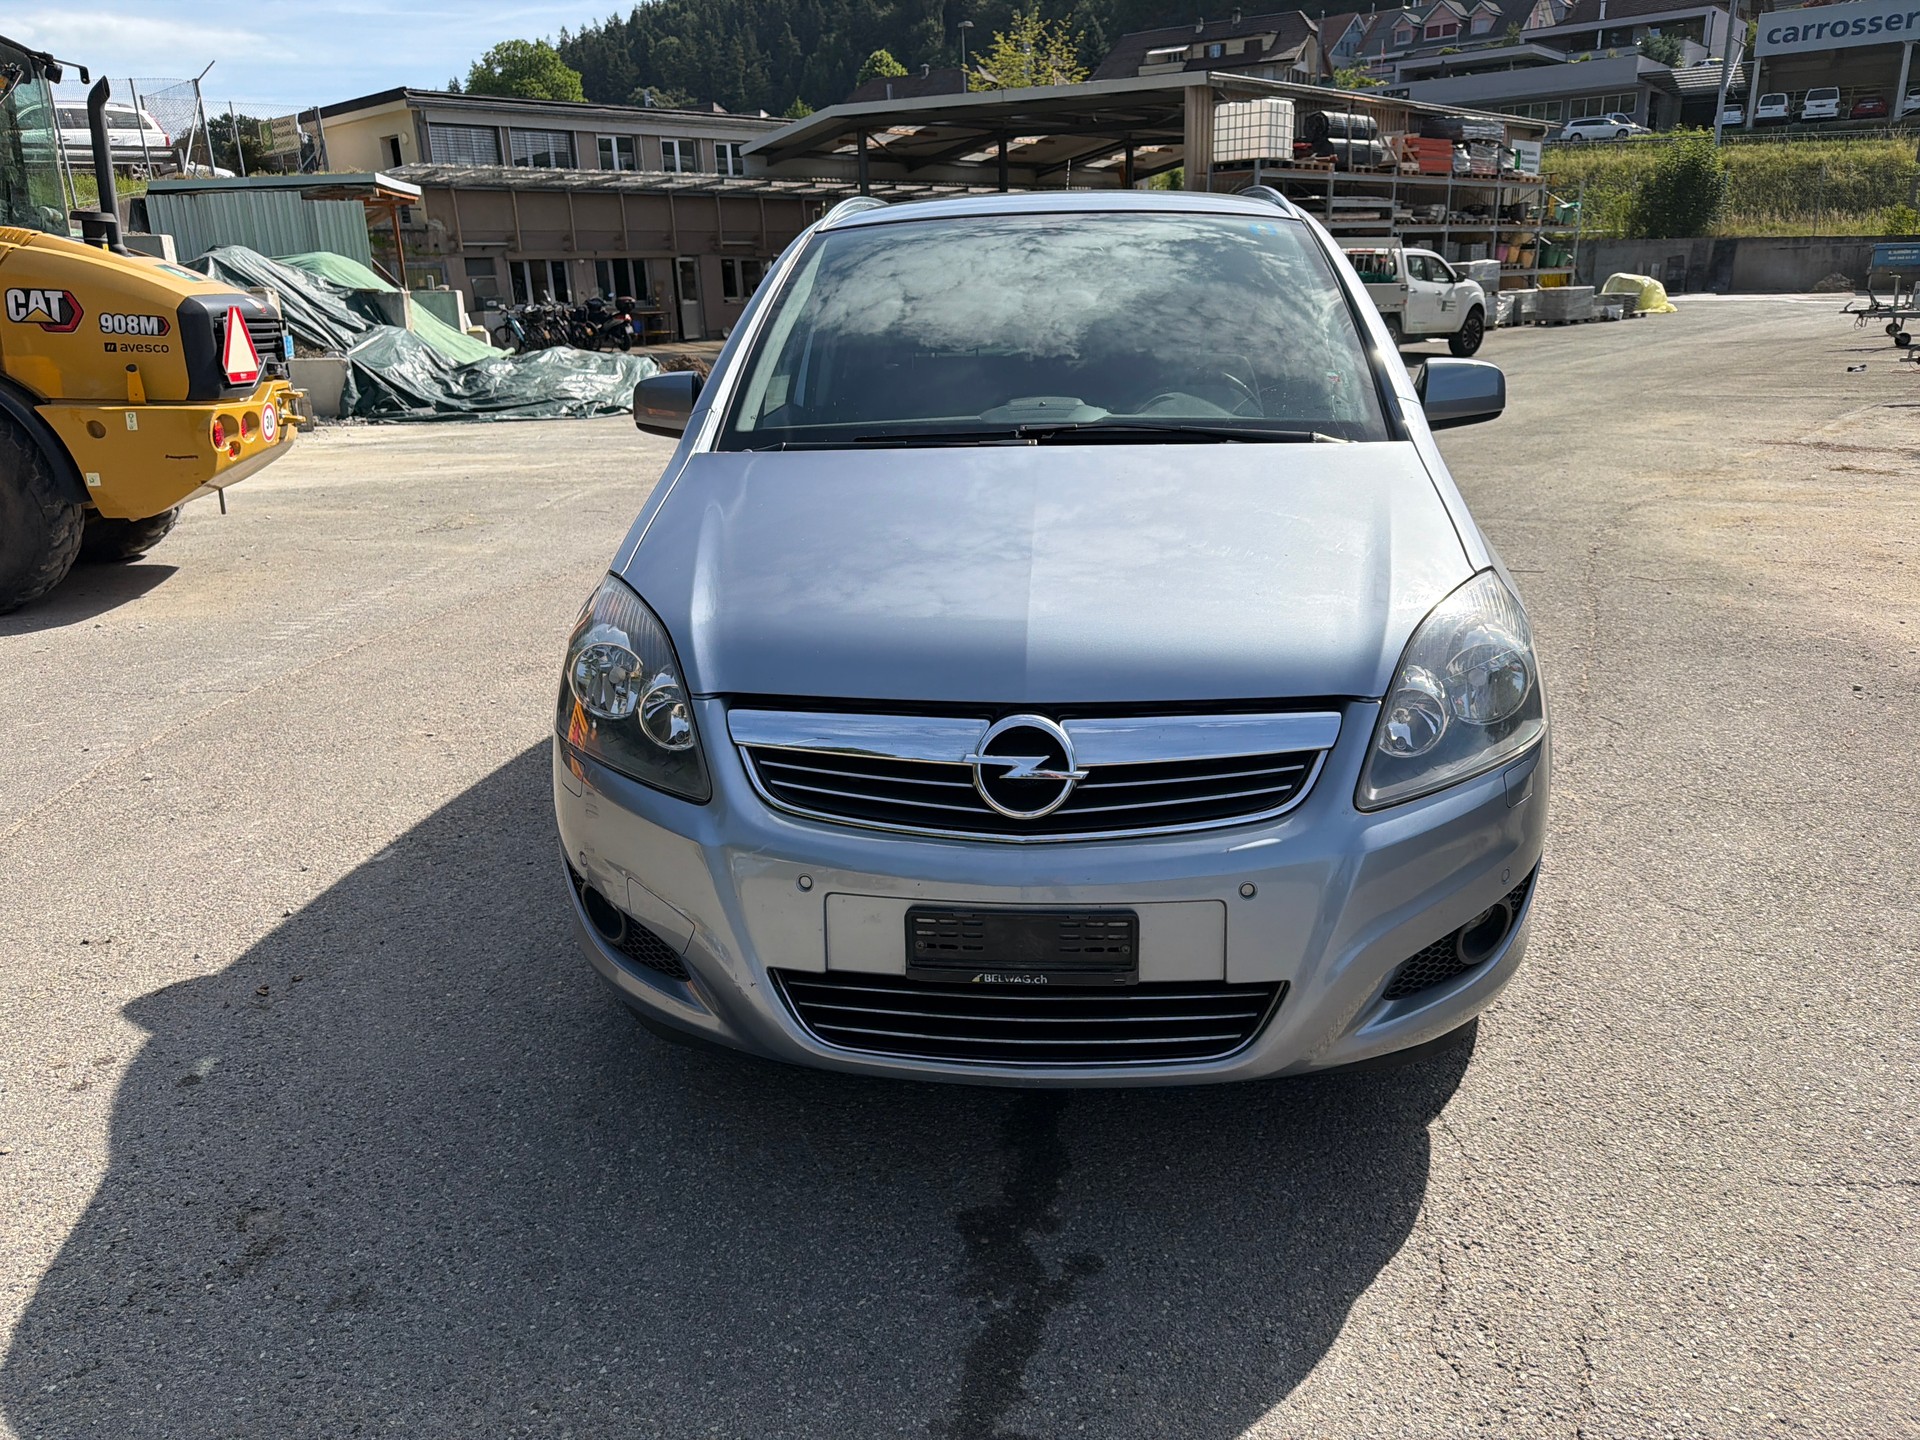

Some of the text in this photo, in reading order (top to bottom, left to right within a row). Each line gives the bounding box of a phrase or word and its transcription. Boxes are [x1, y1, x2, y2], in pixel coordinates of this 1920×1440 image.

[1766, 11, 1920, 44] carrosser
[7, 290, 63, 322] CAT
[100, 314, 159, 335] 908M
[120, 343, 169, 353] avesco
[984, 973, 1048, 984] BELWAG.ch
